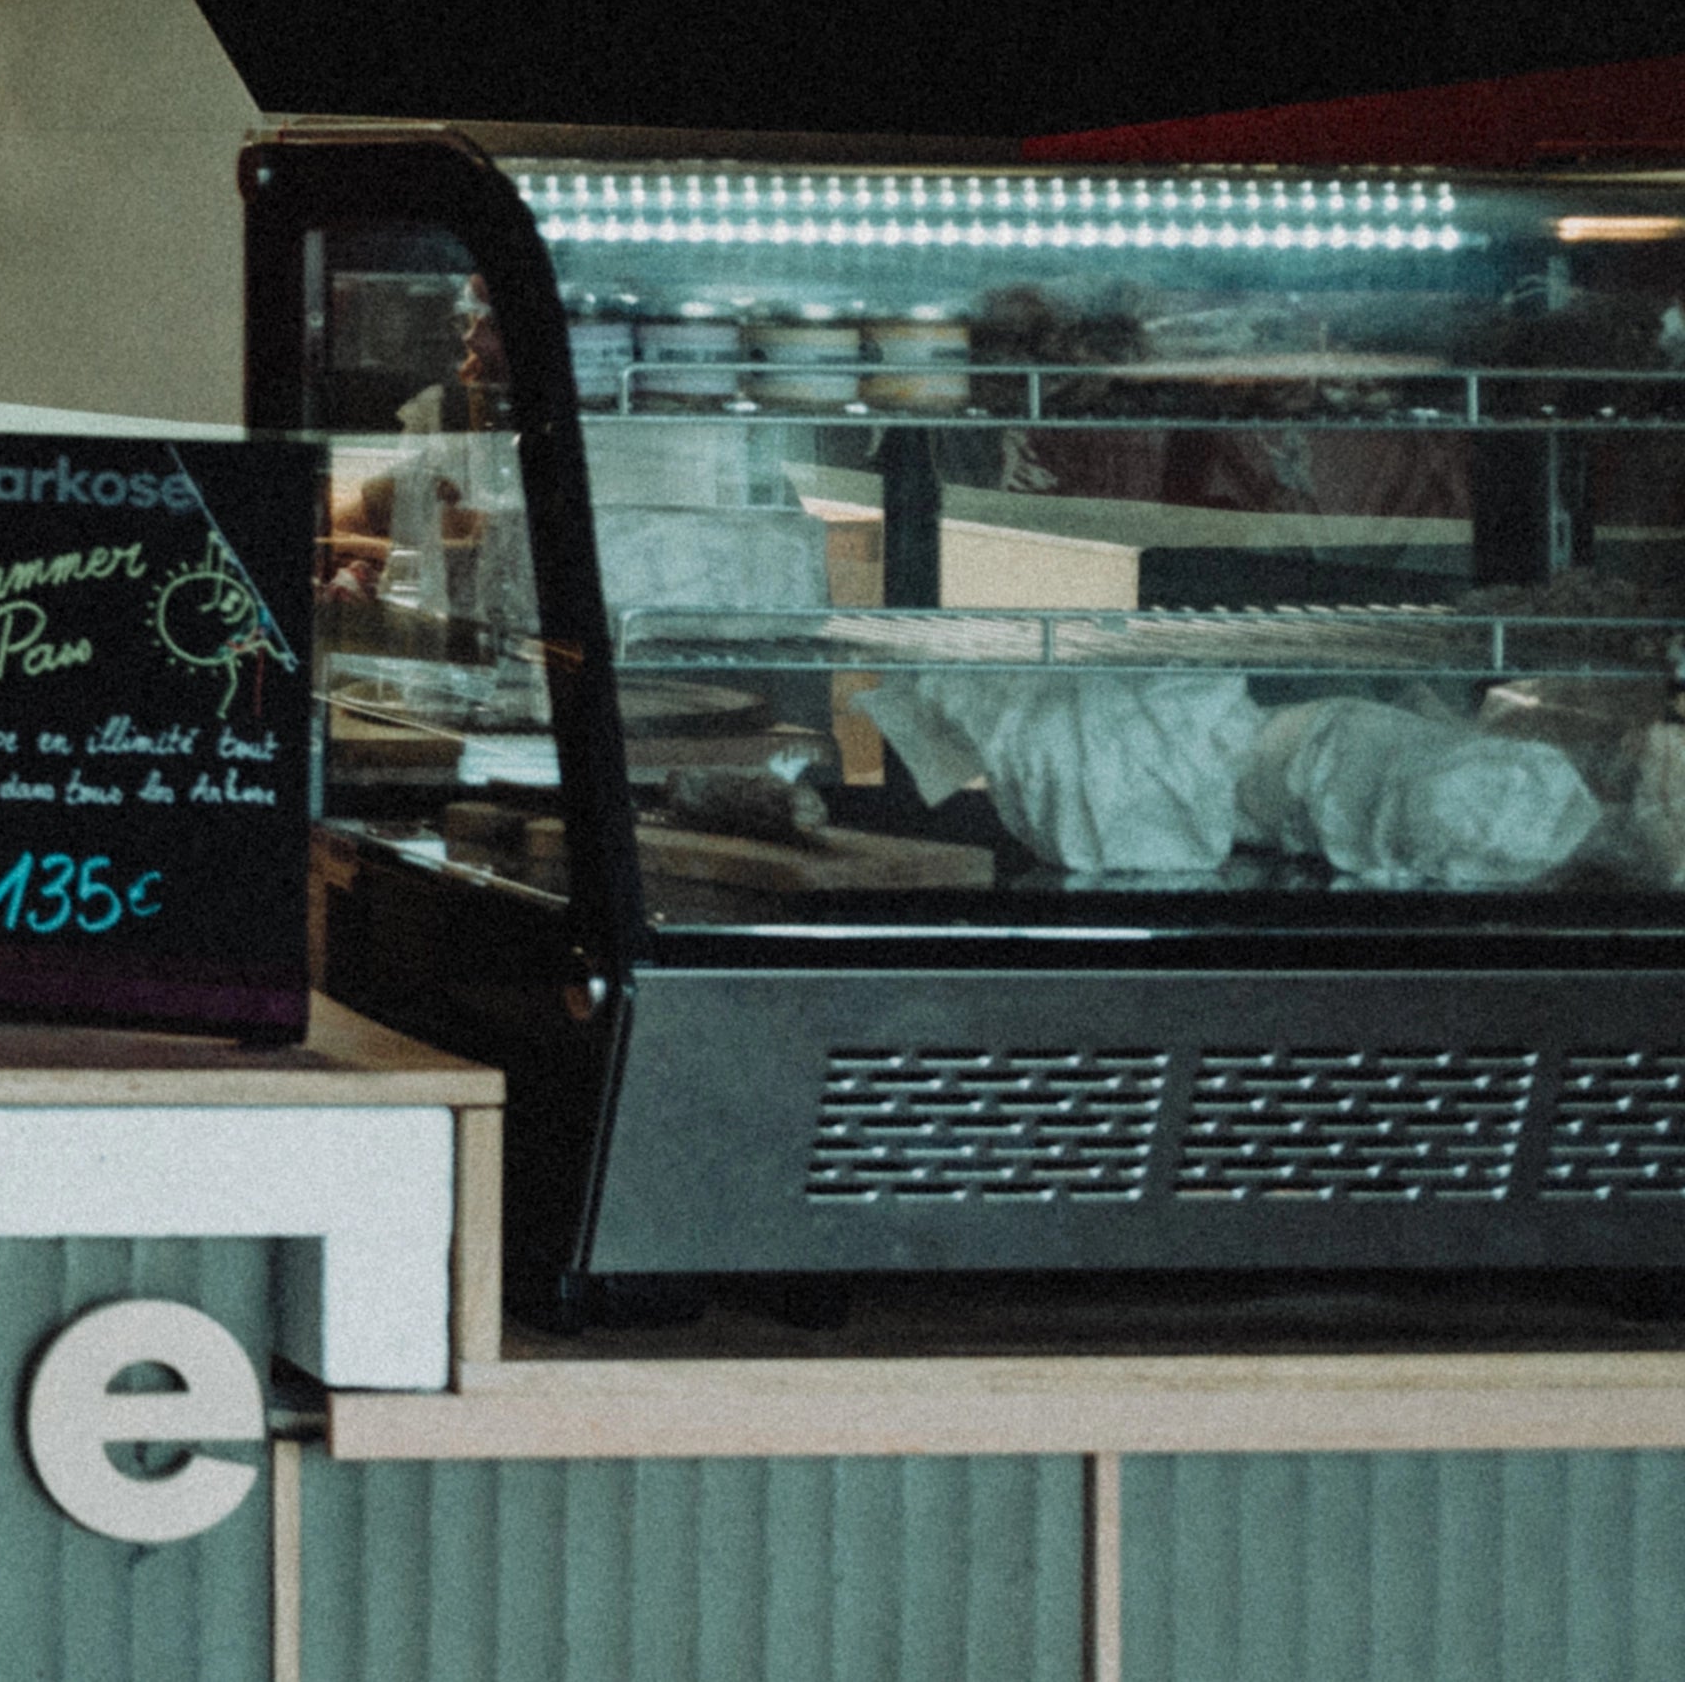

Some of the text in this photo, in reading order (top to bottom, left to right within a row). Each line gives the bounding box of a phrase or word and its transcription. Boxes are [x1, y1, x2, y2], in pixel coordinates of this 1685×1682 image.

[37, 731, 73, 756] en
[84, 714, 200, 756] illimité
[217, 726, 279, 761] tout
[65, 767, 125, 806] tous
